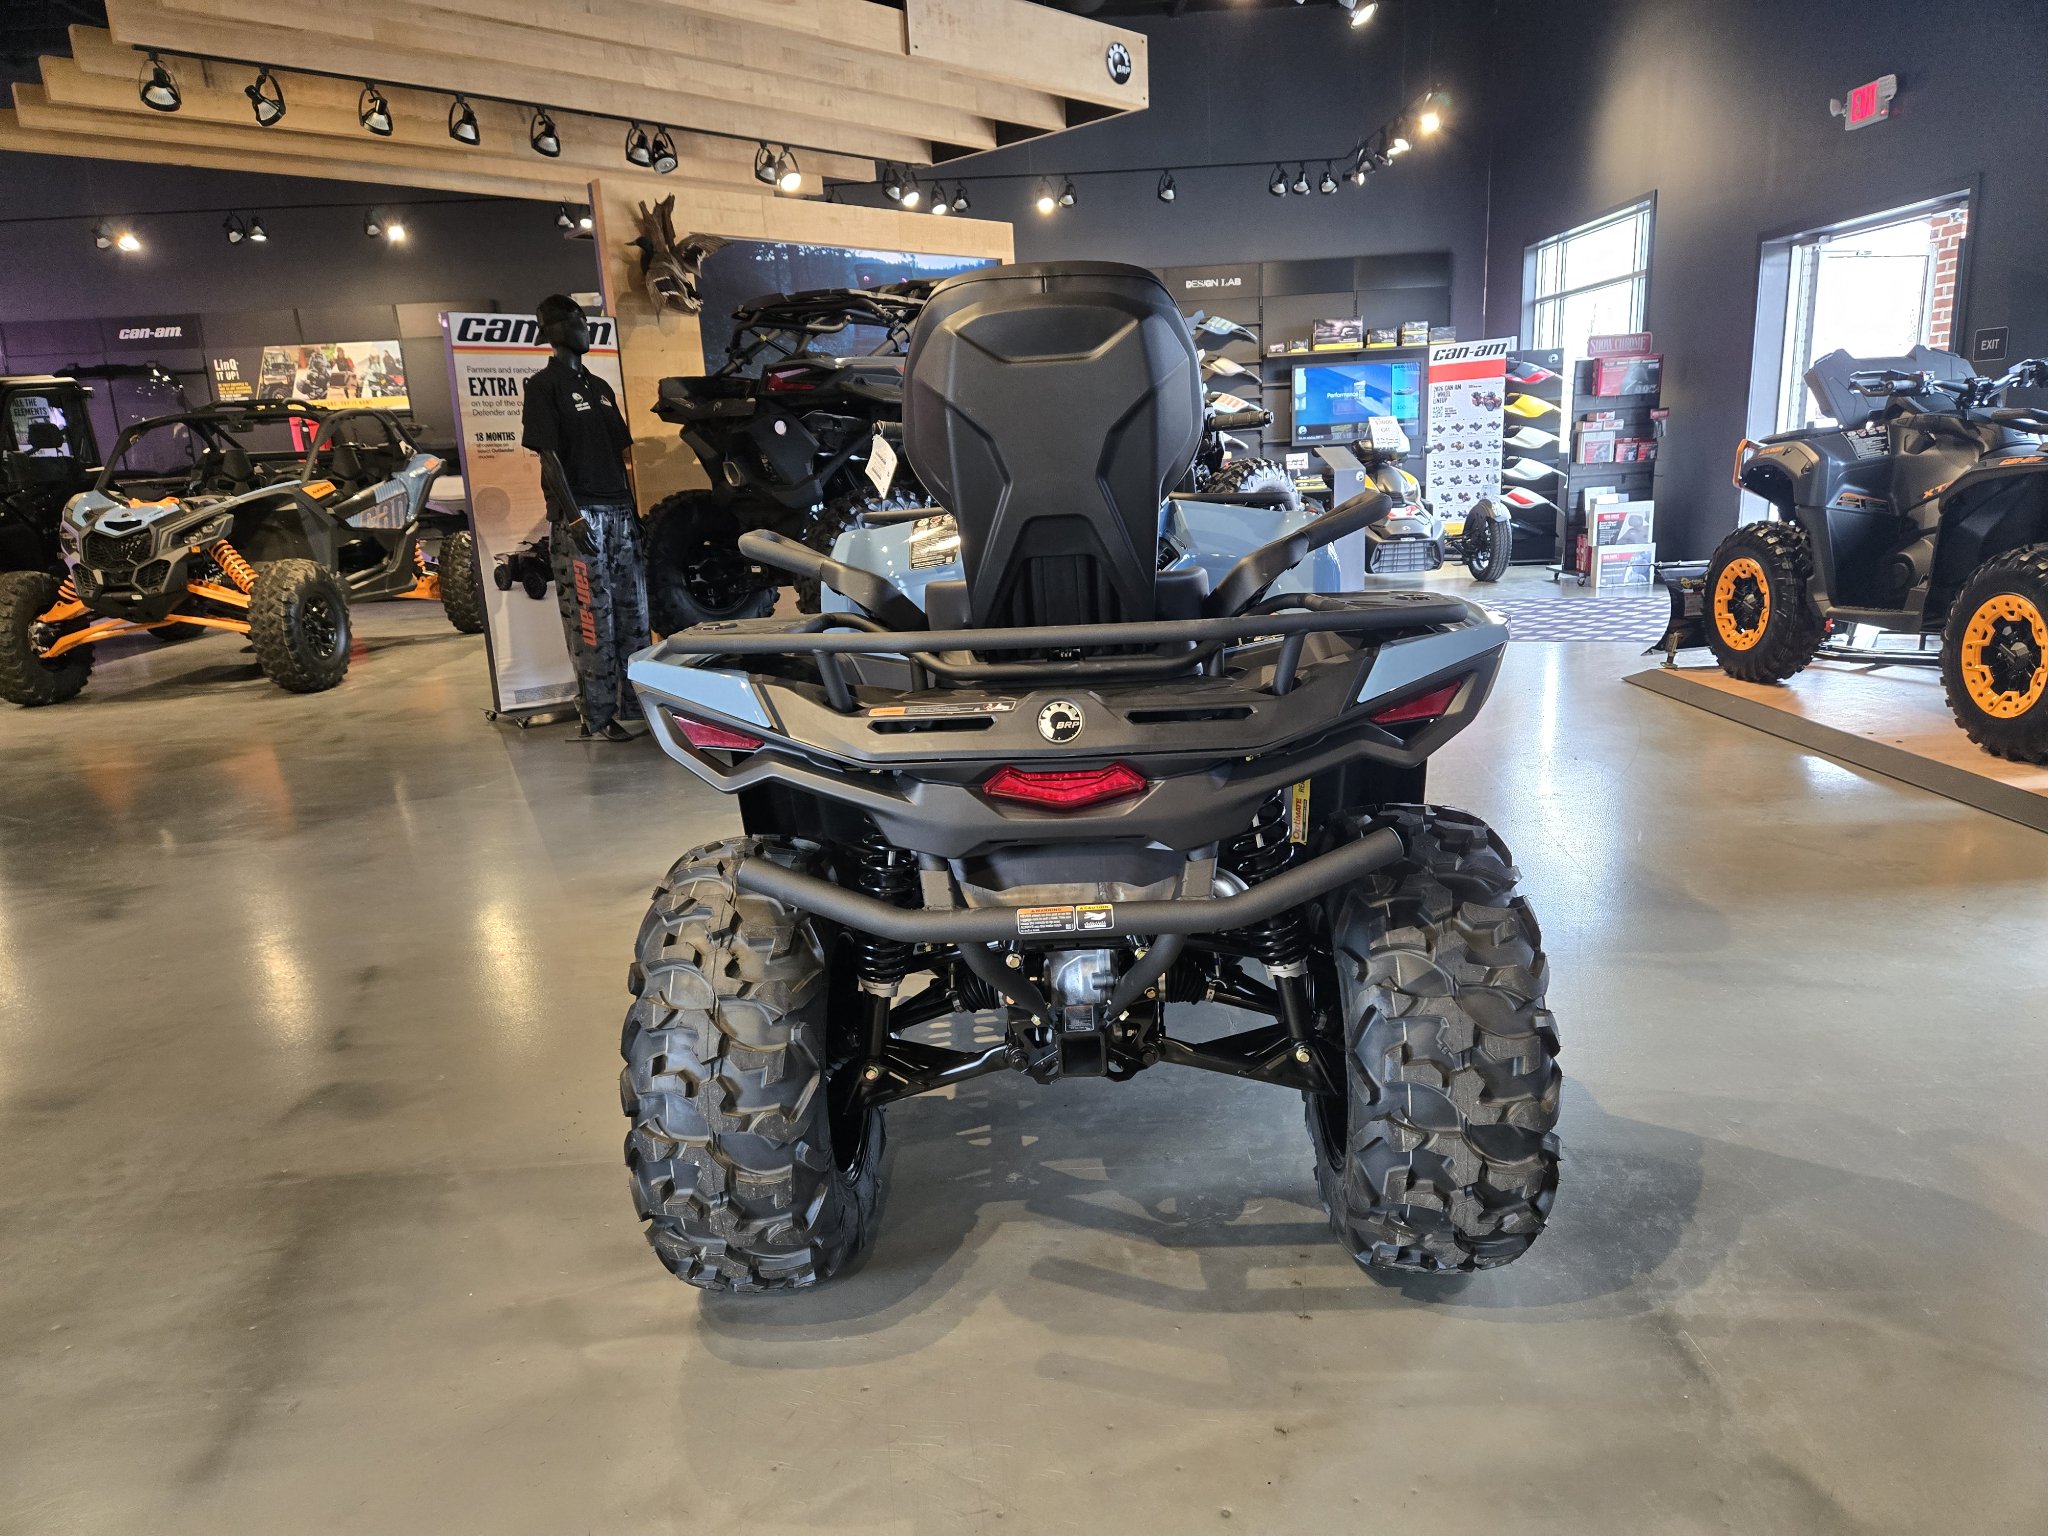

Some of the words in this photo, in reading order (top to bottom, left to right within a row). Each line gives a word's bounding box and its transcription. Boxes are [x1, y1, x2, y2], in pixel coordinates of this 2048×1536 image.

[1116, 64, 1131, 74] BRP
[1185, 279, 1219, 289] DESIGN
[1221, 277, 1242, 287] LAB
[118, 326, 182, 340] can-am
[457, 317, 612, 345] canm
[1980, 338, 2000, 351] EXIT
[1432, 342, 1508, 361] can-am
[213, 358, 238, 372] LinQ
[466, 365, 497, 374] Farmers
[497, 366, 512, 374] and
[512, 366, 541, 374] rancher
[215, 371, 224, 381] IT
[468, 377, 519, 397] EXTRA
[481, 400, 494, 408] top
[13, 406, 48, 417] ELEMENTS
[472, 409, 506, 417] Defender
[506, 408, 521, 416] and
[475, 432, 484, 442] 18
[485, 431, 516, 442] MONTHS
[572, 559, 598, 647] can-am
[1055, 721, 1080, 729] BRP
